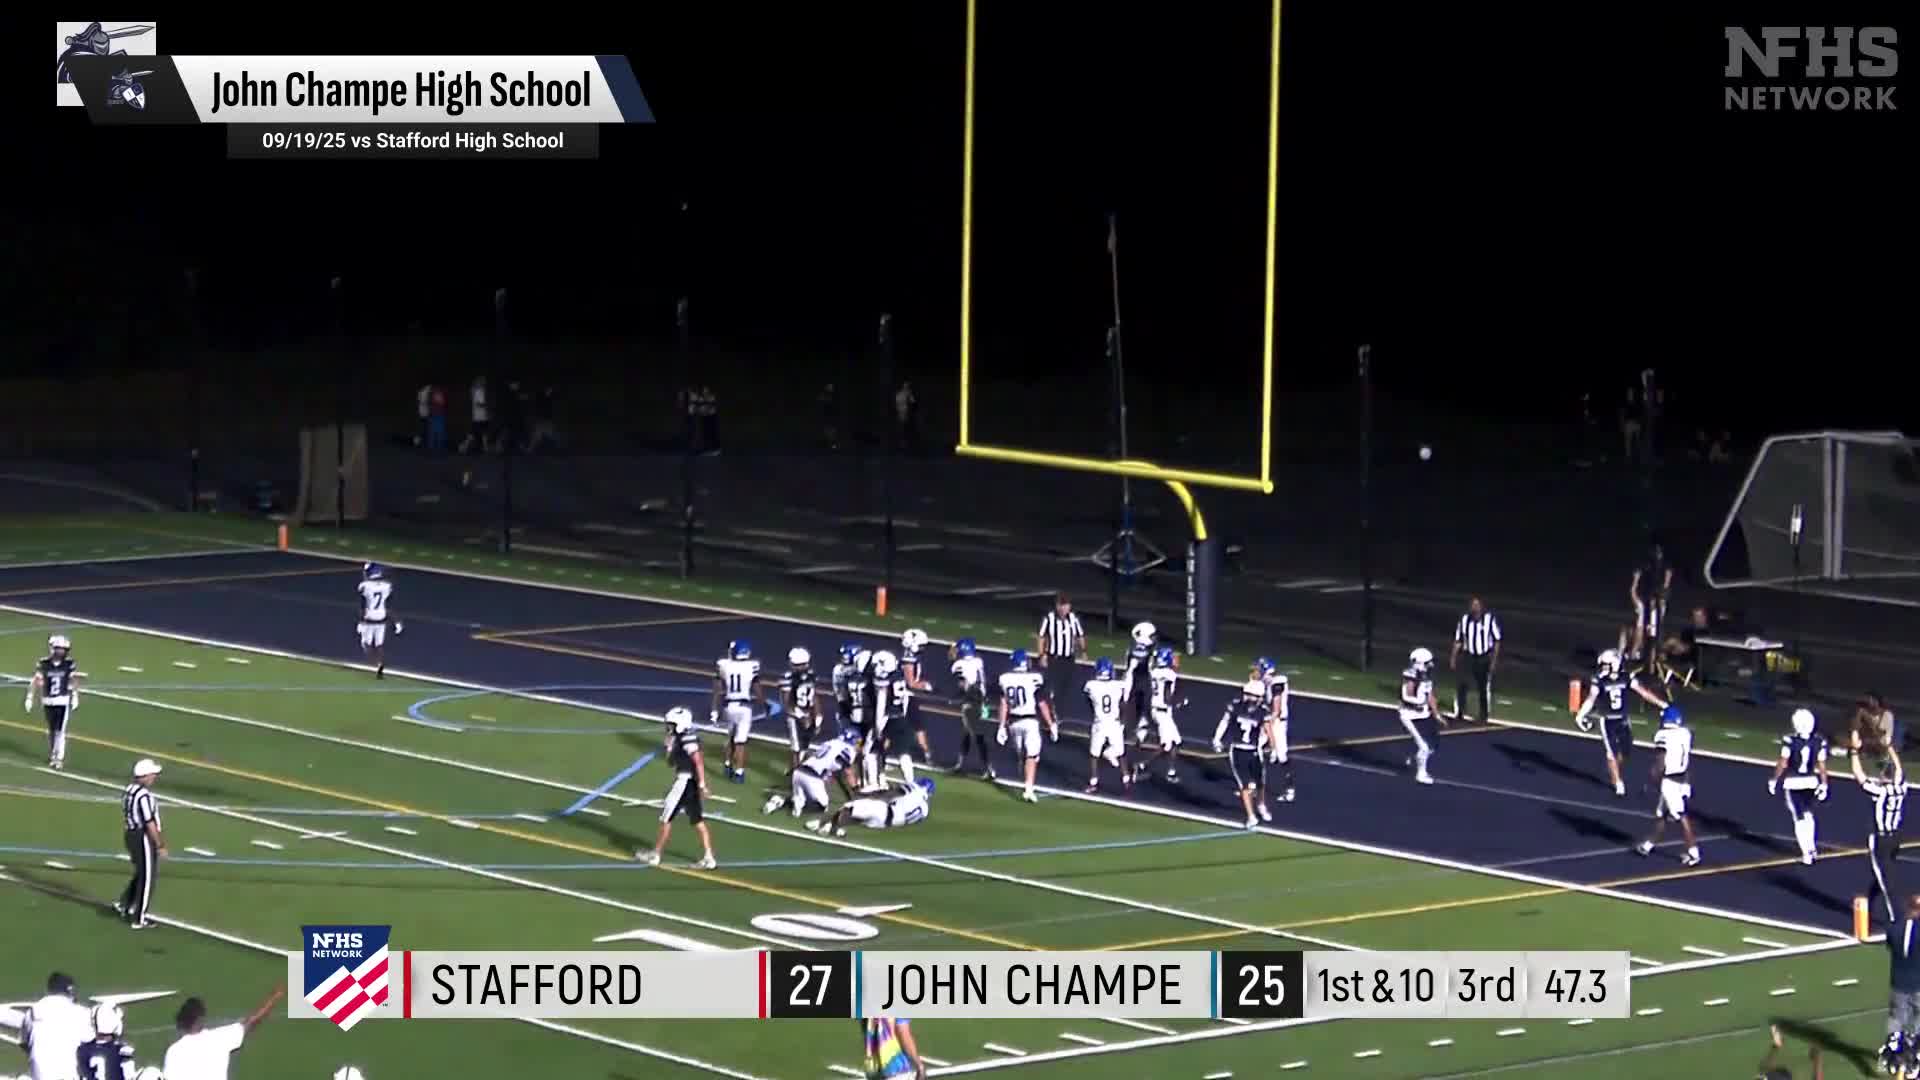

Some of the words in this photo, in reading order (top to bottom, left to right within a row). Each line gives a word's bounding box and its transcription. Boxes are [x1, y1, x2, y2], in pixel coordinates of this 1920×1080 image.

[729, 673, 742, 694] 11
[1102, 694, 1112, 714] 8
[1799, 746, 1811, 774] 1
